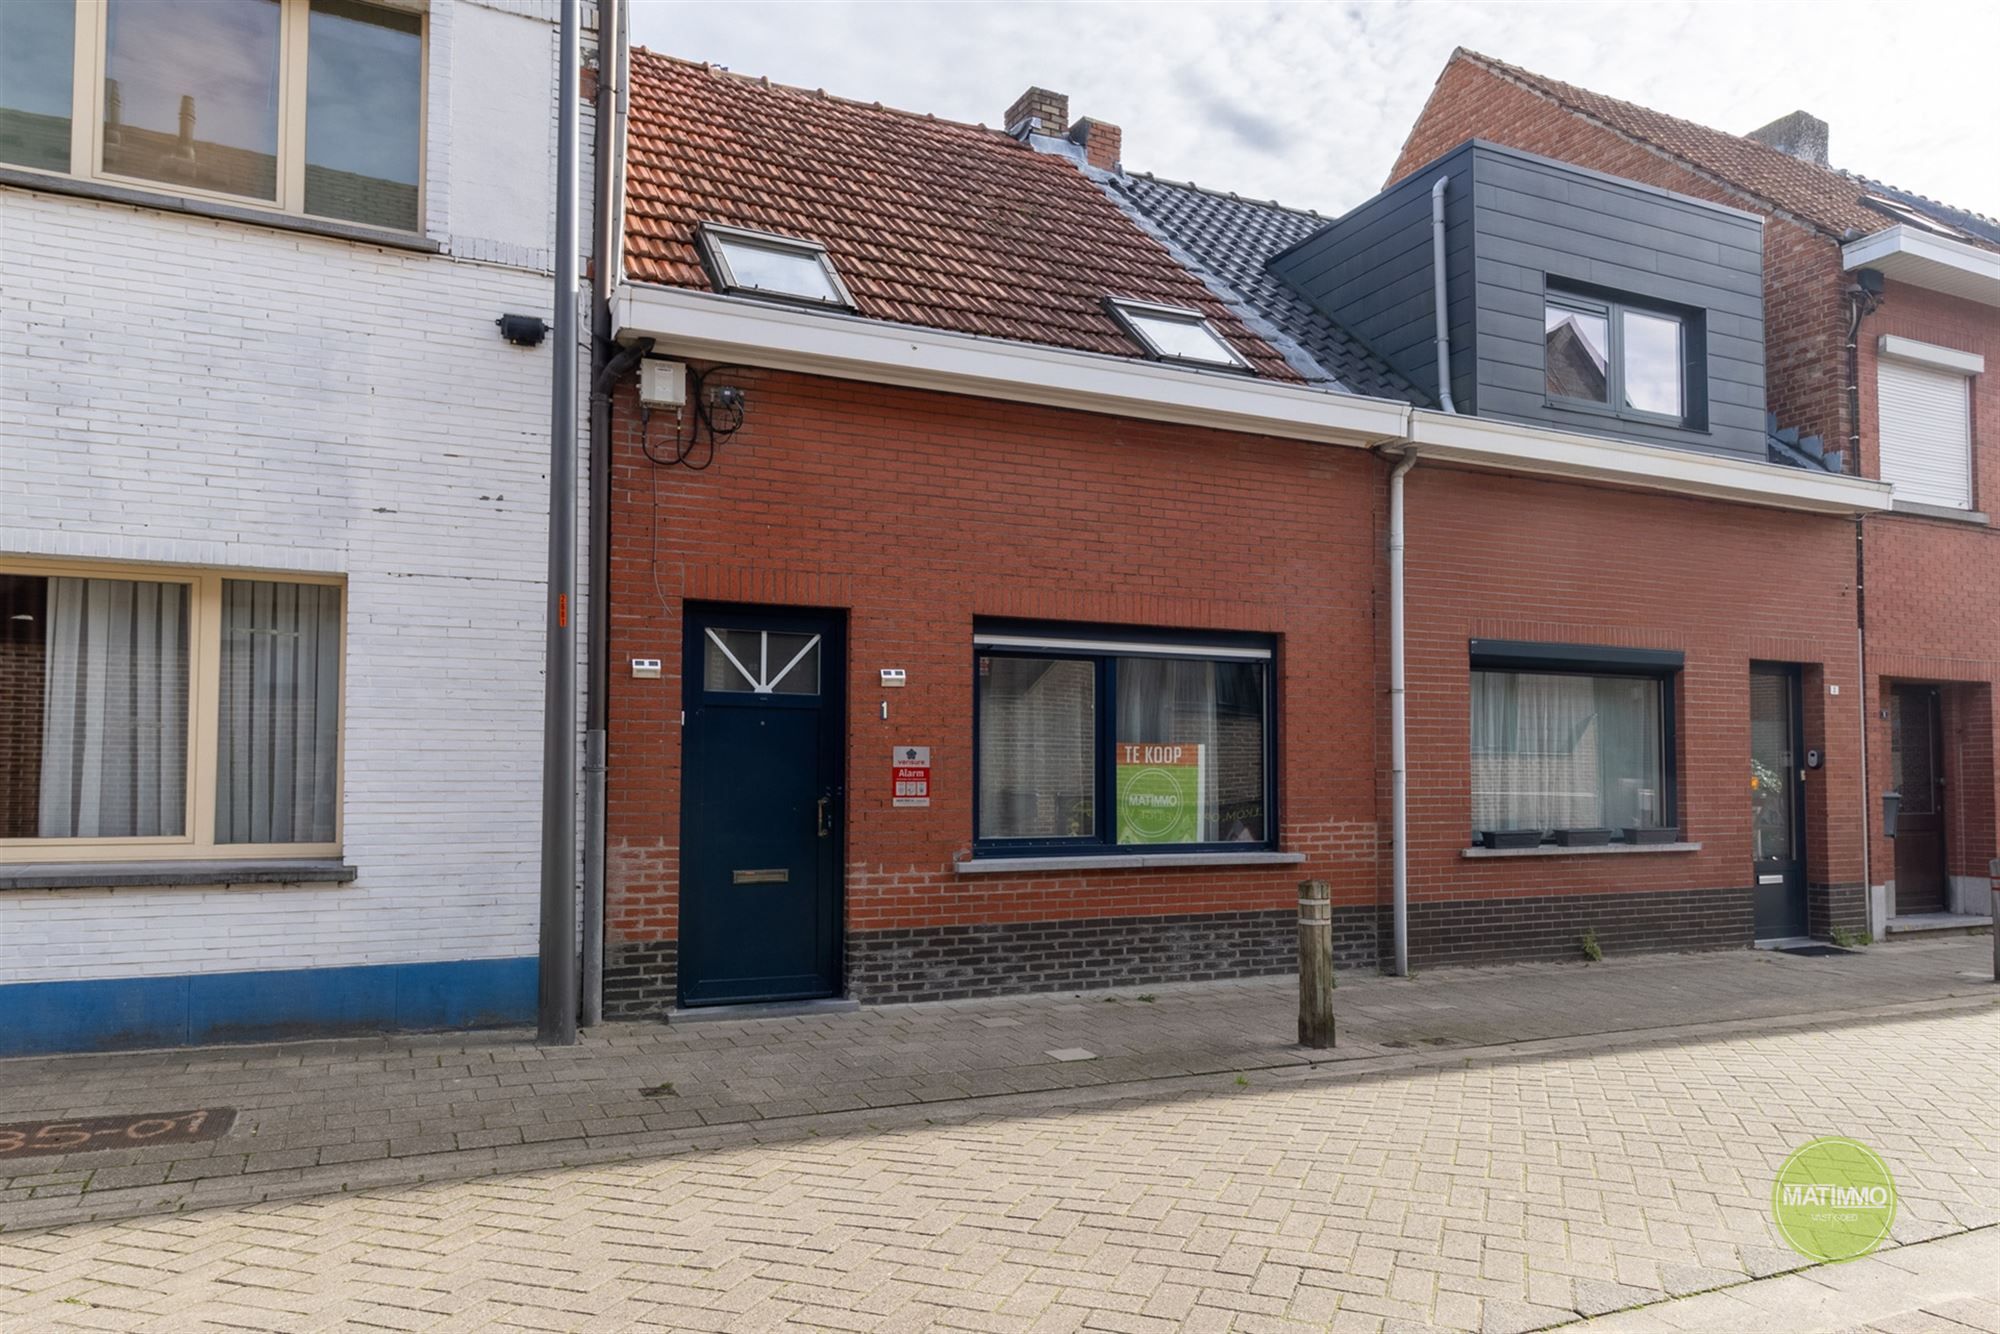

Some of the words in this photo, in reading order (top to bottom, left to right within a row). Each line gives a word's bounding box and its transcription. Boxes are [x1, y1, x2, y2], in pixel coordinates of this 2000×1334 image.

[881, 701, 888, 719] 1
[1125, 746, 1140, 764] TE
[1145, 746, 1182, 764] KOOP
[898, 768, 925, 777] Alarm
[1129, 795, 1177, 806] MATIMMO
